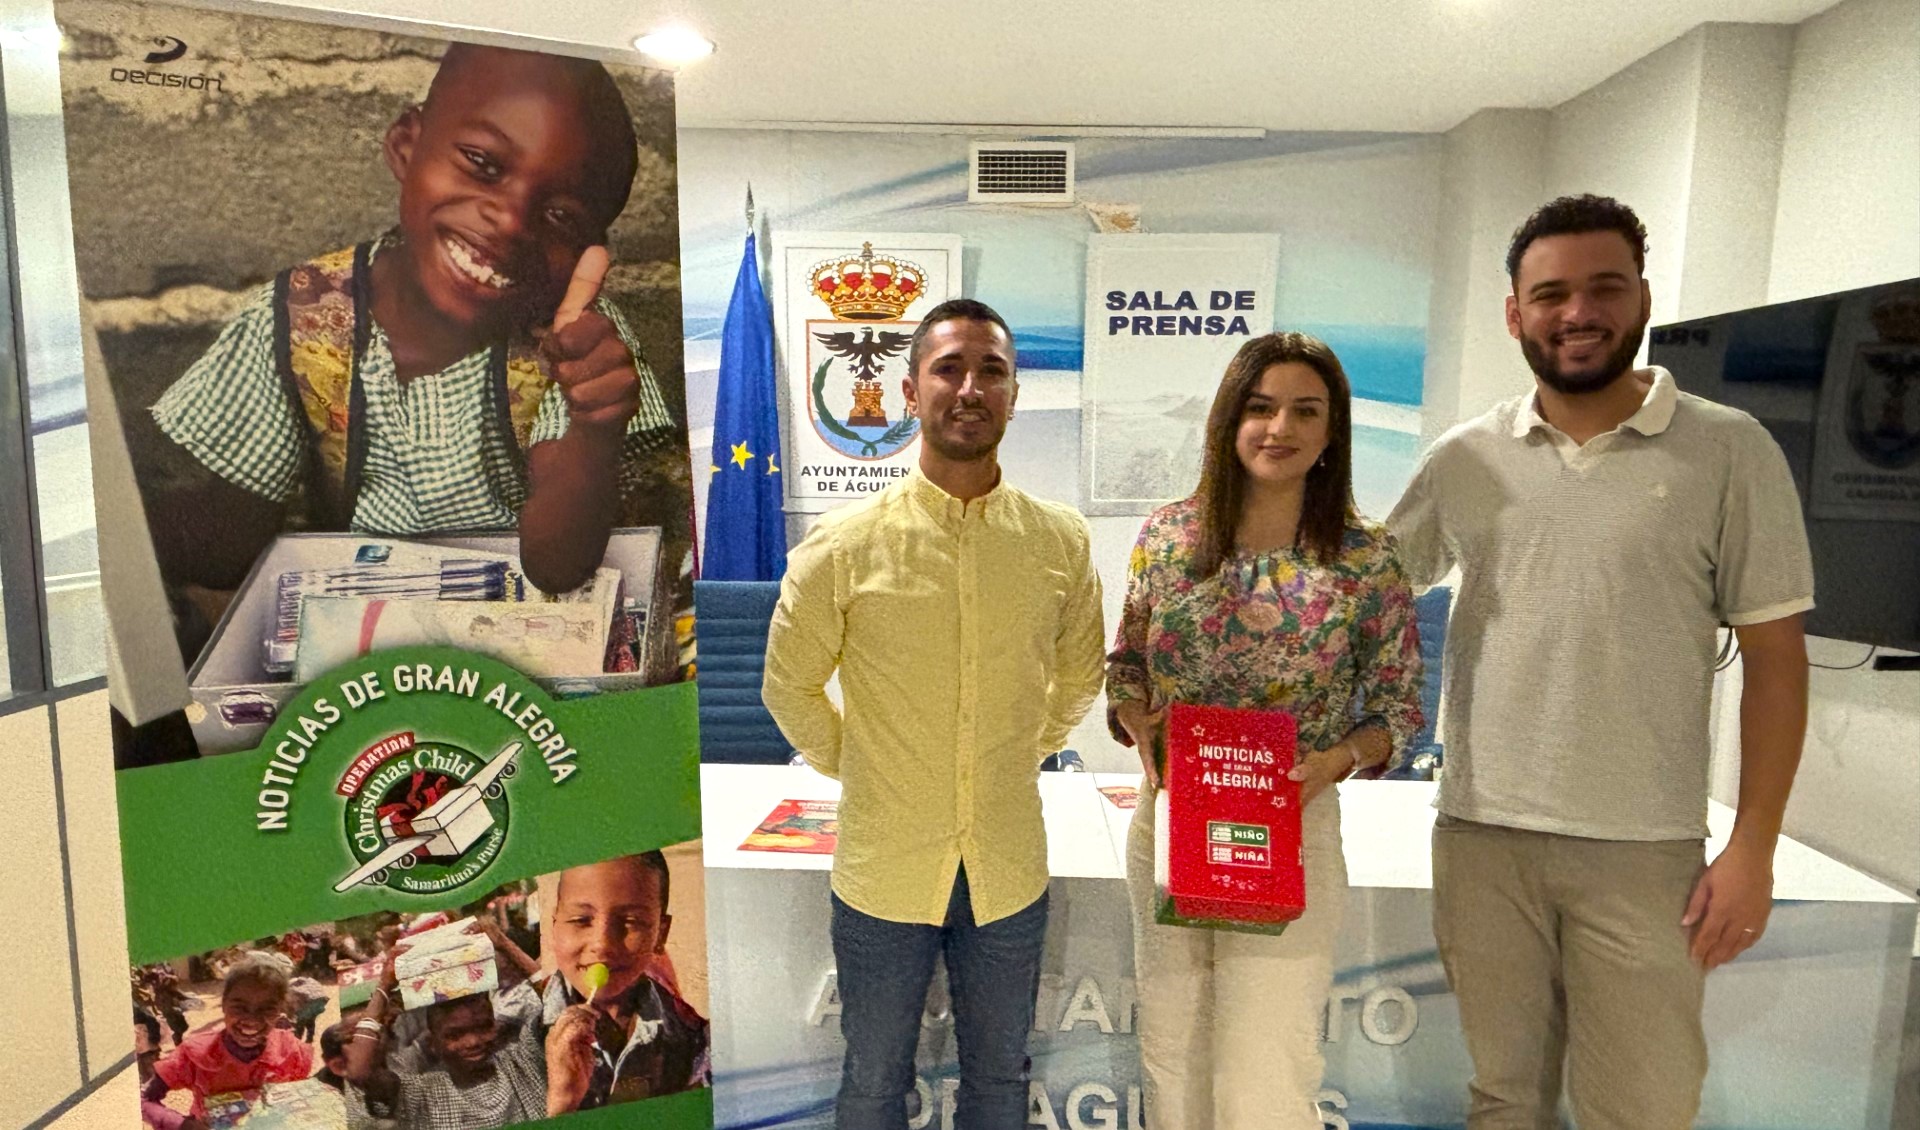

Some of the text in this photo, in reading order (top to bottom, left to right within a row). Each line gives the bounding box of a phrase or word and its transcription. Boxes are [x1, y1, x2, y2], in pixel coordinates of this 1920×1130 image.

[1105, 290, 1255, 311] SALA DE
[1108, 315, 1250, 336] PRENSA
[801, 466, 911, 478] AYUNTAMIEN
[817, 481, 839, 492] DE
[257, 664, 577, 830] NOTICIAS DE GRAN ALEGRÍA
[341, 734, 411, 794] OPERATION
[354, 749, 475, 853] Christmas Child
[1234, 829, 1264, 841] NIÑO
